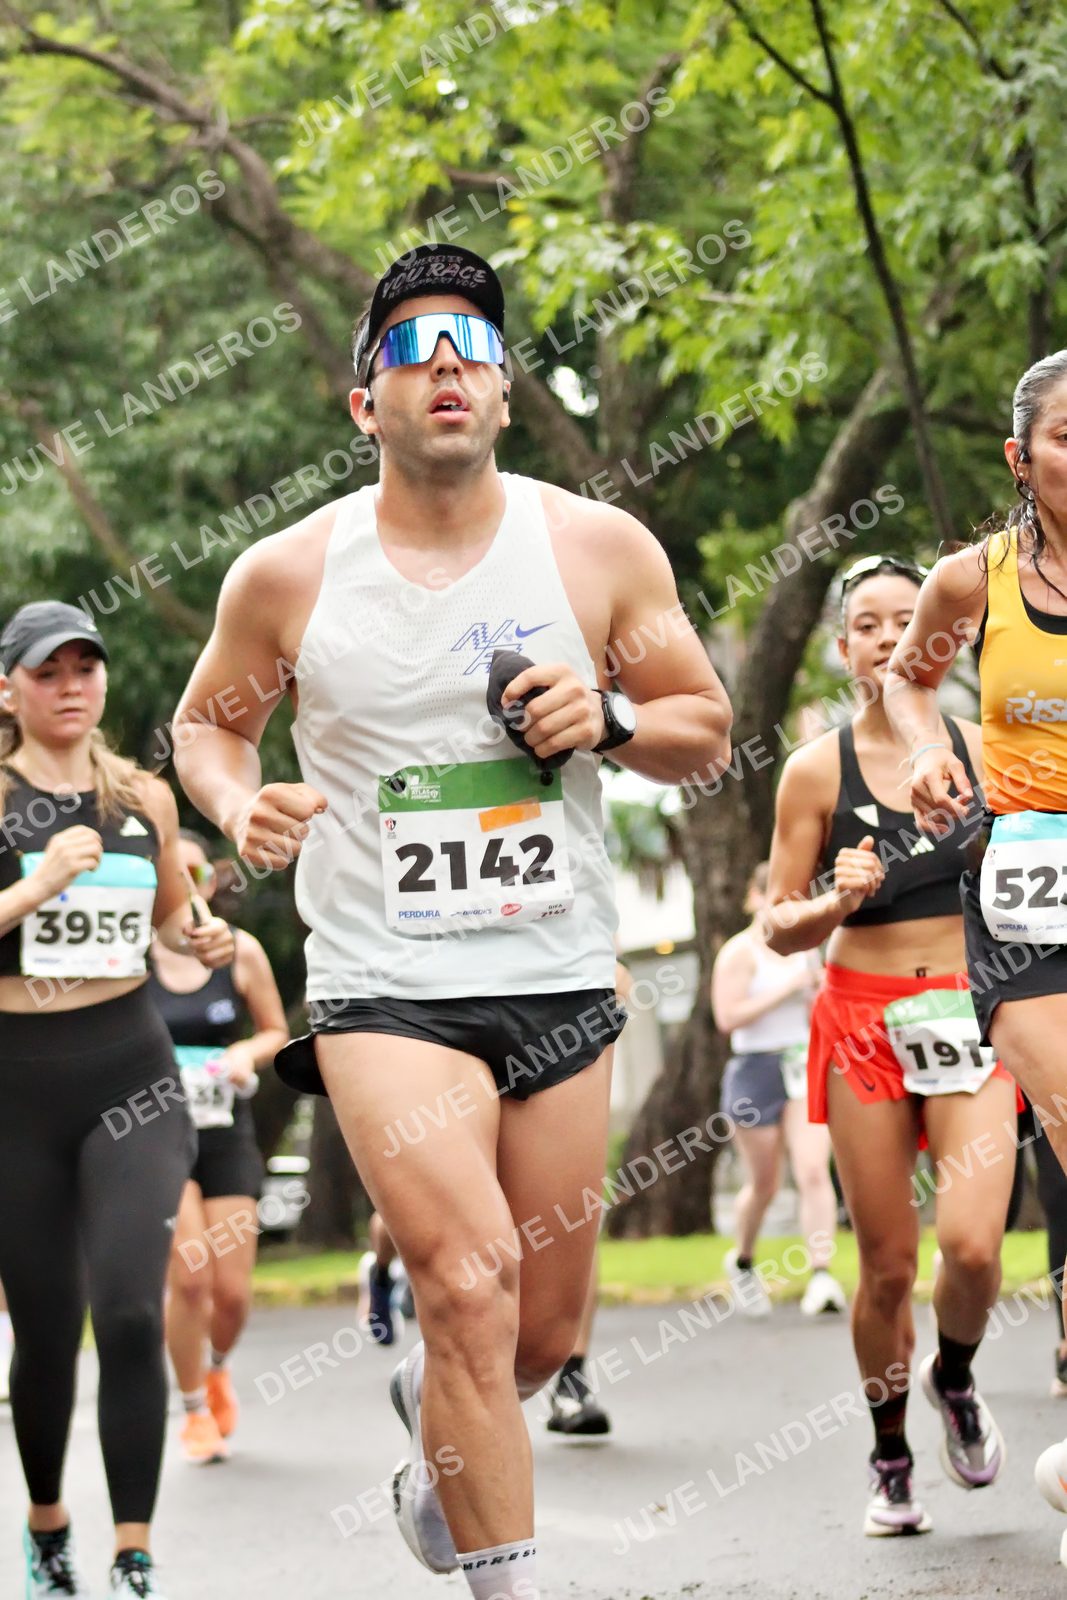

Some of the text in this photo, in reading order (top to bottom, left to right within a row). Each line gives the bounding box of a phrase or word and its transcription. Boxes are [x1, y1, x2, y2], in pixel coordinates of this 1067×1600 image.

[426, 262, 487, 284] RACE
[395, 834, 555, 892] 2142
[992, 866, 1067, 910] 52
[34, 910, 142, 945] 3956
[398, 909, 441, 919] PERDURA
[905, 1039, 999, 1069] 191
